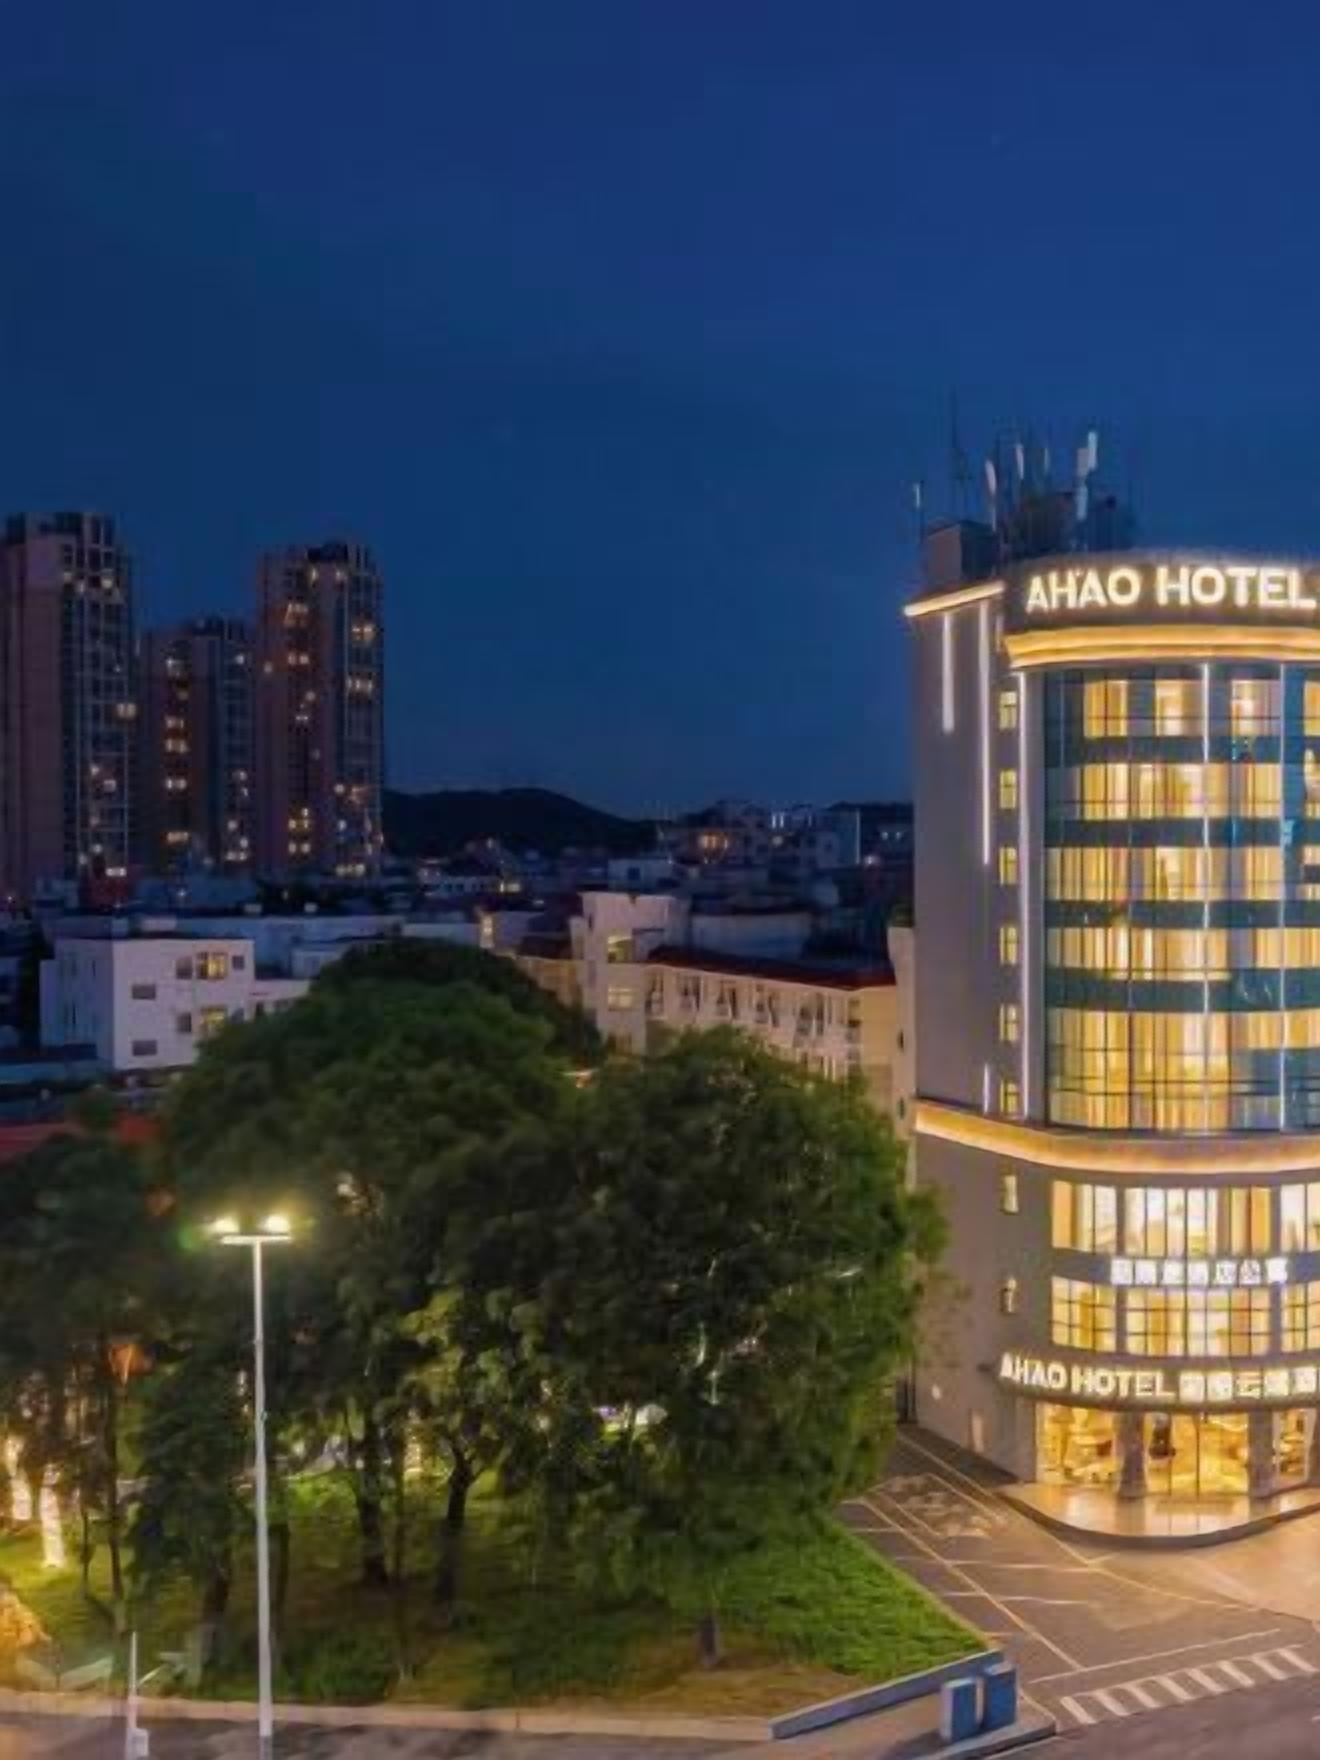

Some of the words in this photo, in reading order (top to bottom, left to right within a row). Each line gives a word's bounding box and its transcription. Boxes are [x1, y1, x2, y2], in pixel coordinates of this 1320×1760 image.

[1025, 567, 1141, 613] AHAO
[1156, 565, 1317, 610] HOTEL
[1000, 1352, 1068, 1390] AHAO
[1071, 1366, 1175, 1397] HOTEL
